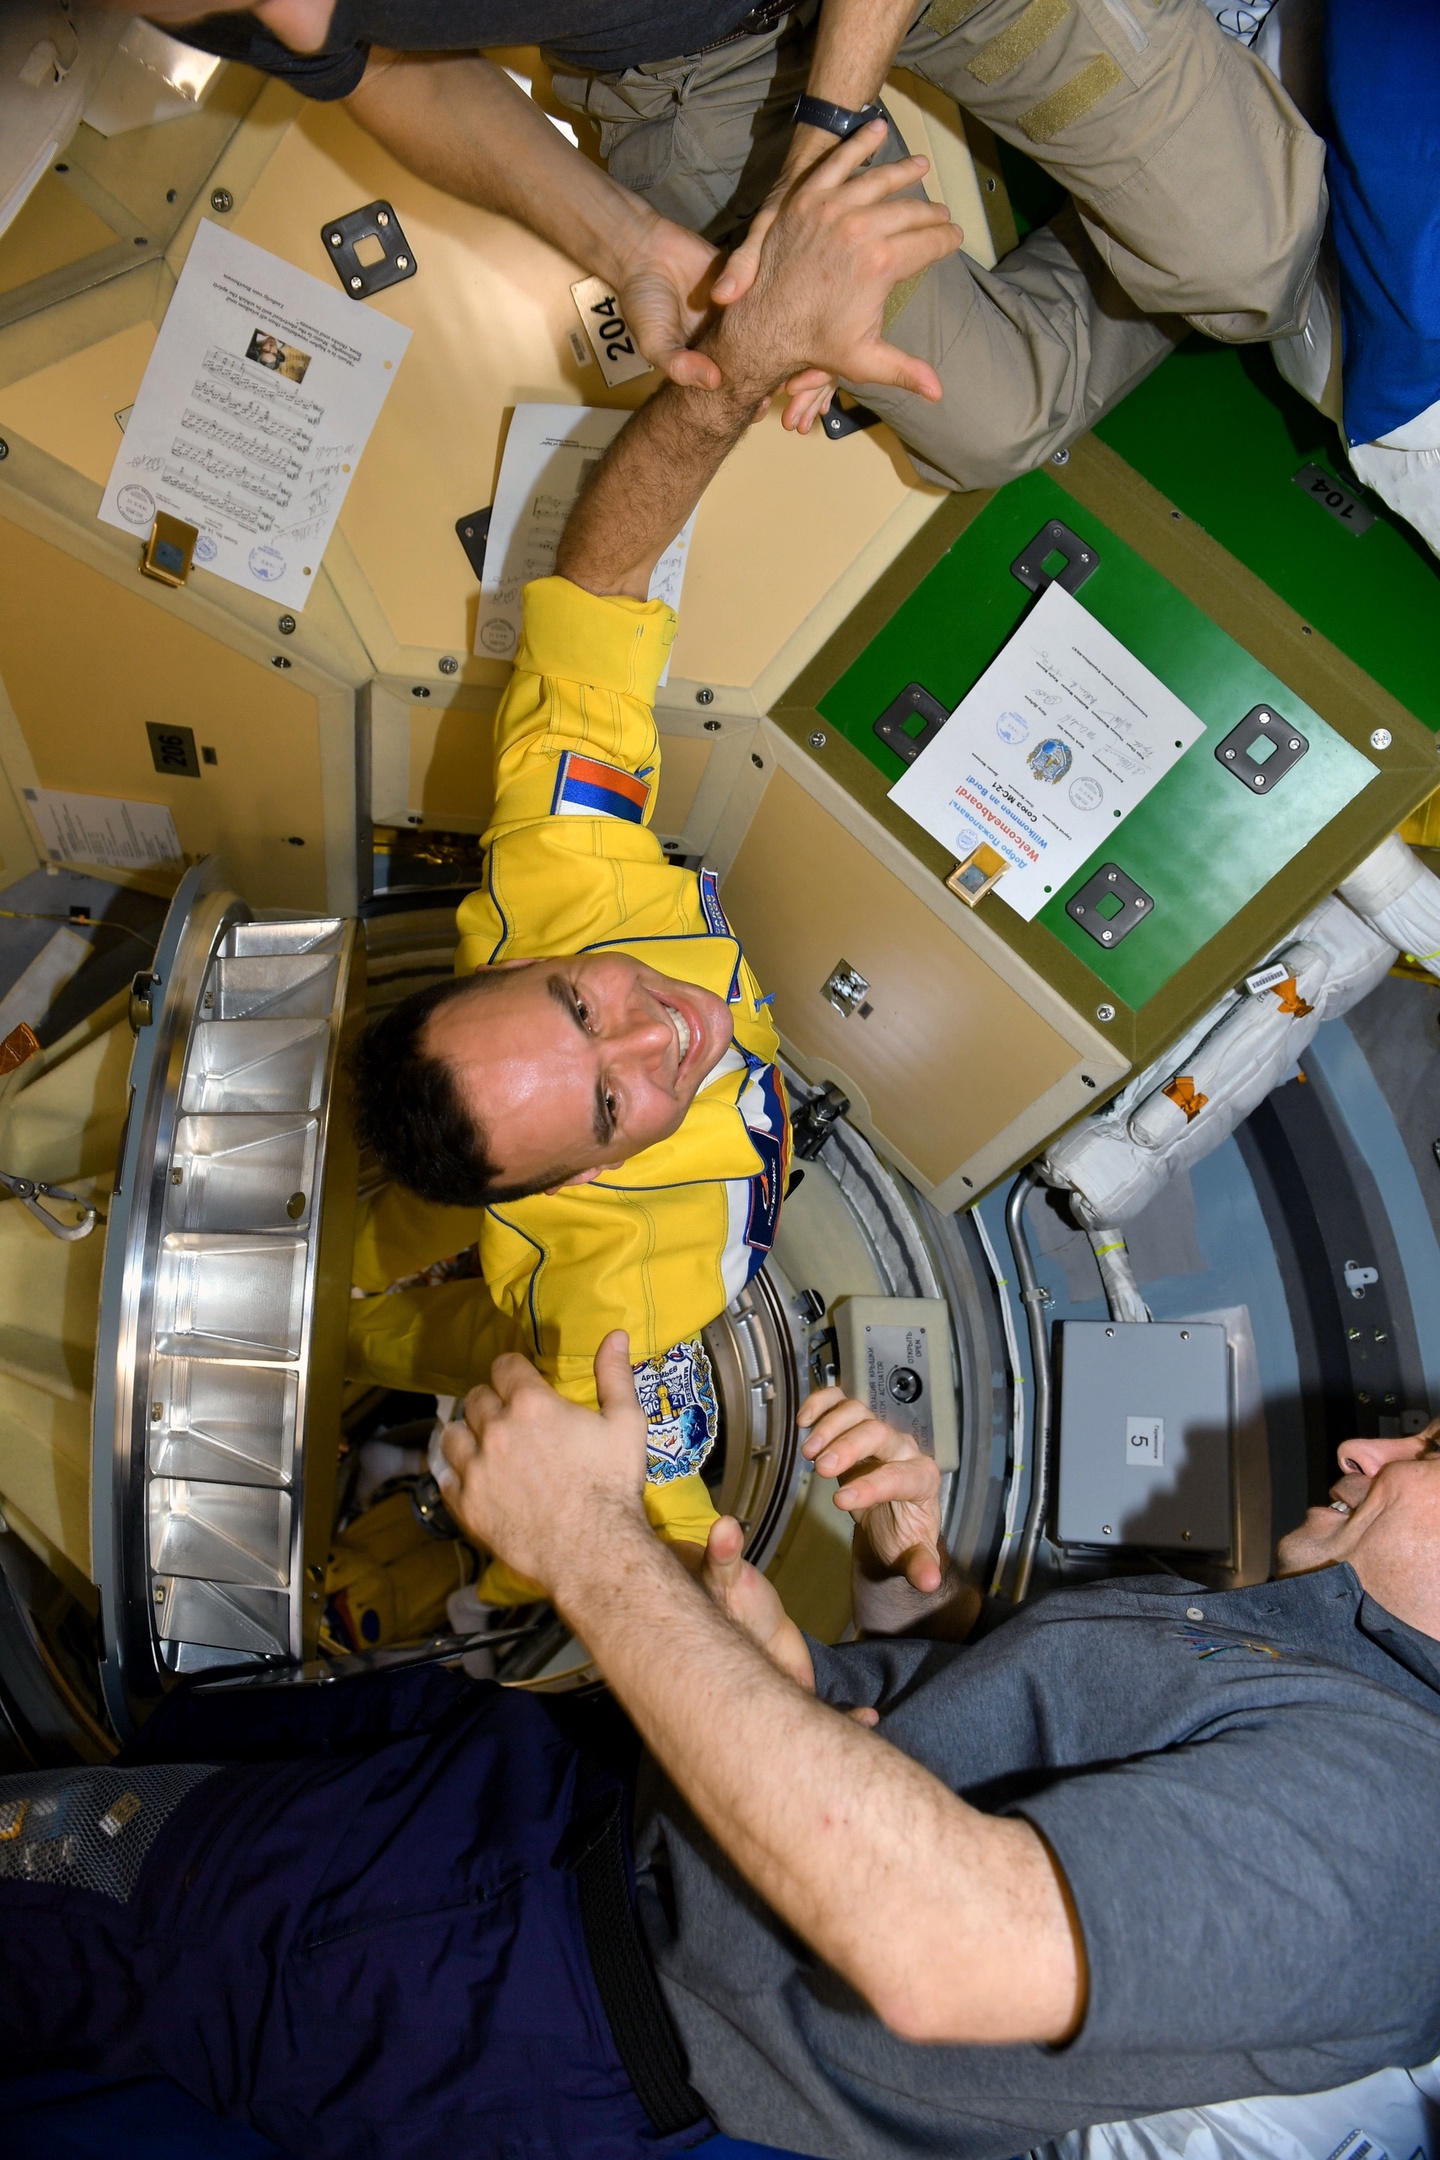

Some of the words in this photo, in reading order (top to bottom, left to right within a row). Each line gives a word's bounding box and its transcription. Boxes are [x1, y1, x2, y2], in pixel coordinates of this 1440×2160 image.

[590, 296, 635, 361] 204
[1310, 479, 1354, 518] 104
[158, 734, 188, 768] 206
[965, 774, 988, 796] Bord!
[991, 780, 1016, 803] МС-21
[988, 793, 1000, 805] an
[1014, 800, 1038, 822] Союз
[947, 798, 1000, 846] Пожаловать!
[954, 784, 1040, 862] WelcomeAboard!
[998, 803, 1048, 848] Willkommen
[998, 842, 1028, 869] Добро
[767, 1157, 776, 1226] РОСКОСМОС
[641, 1365, 678, 1381] АРТЕМЬЕВ
[682, 1366, 692, 1402] МАТВЕЕВ
[671, 1393, 683, 1406] 21
[920, 1425, 928, 1446] CLOSE
[1130, 1435, 1148, 1446] 5
